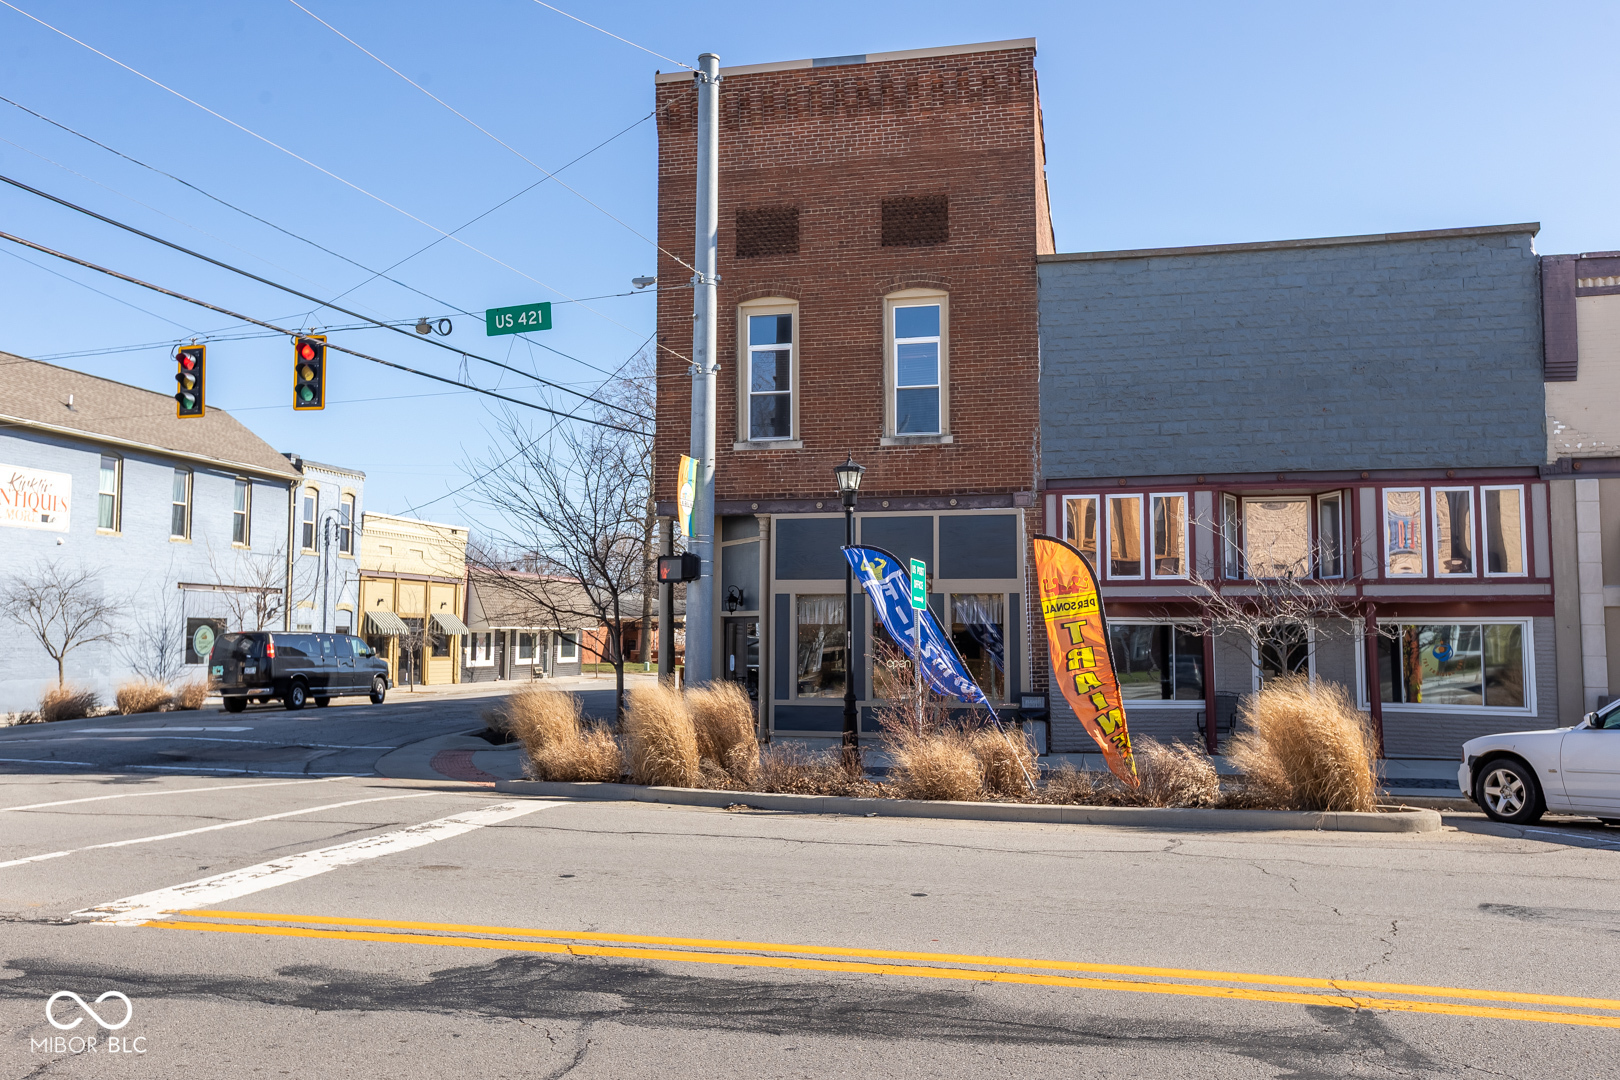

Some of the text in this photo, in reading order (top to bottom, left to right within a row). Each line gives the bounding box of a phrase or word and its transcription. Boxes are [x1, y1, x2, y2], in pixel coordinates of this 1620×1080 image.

[496, 310, 542, 328] US 421
[0, 488, 68, 513] NTIQUES
[886, 659, 912, 670] open
